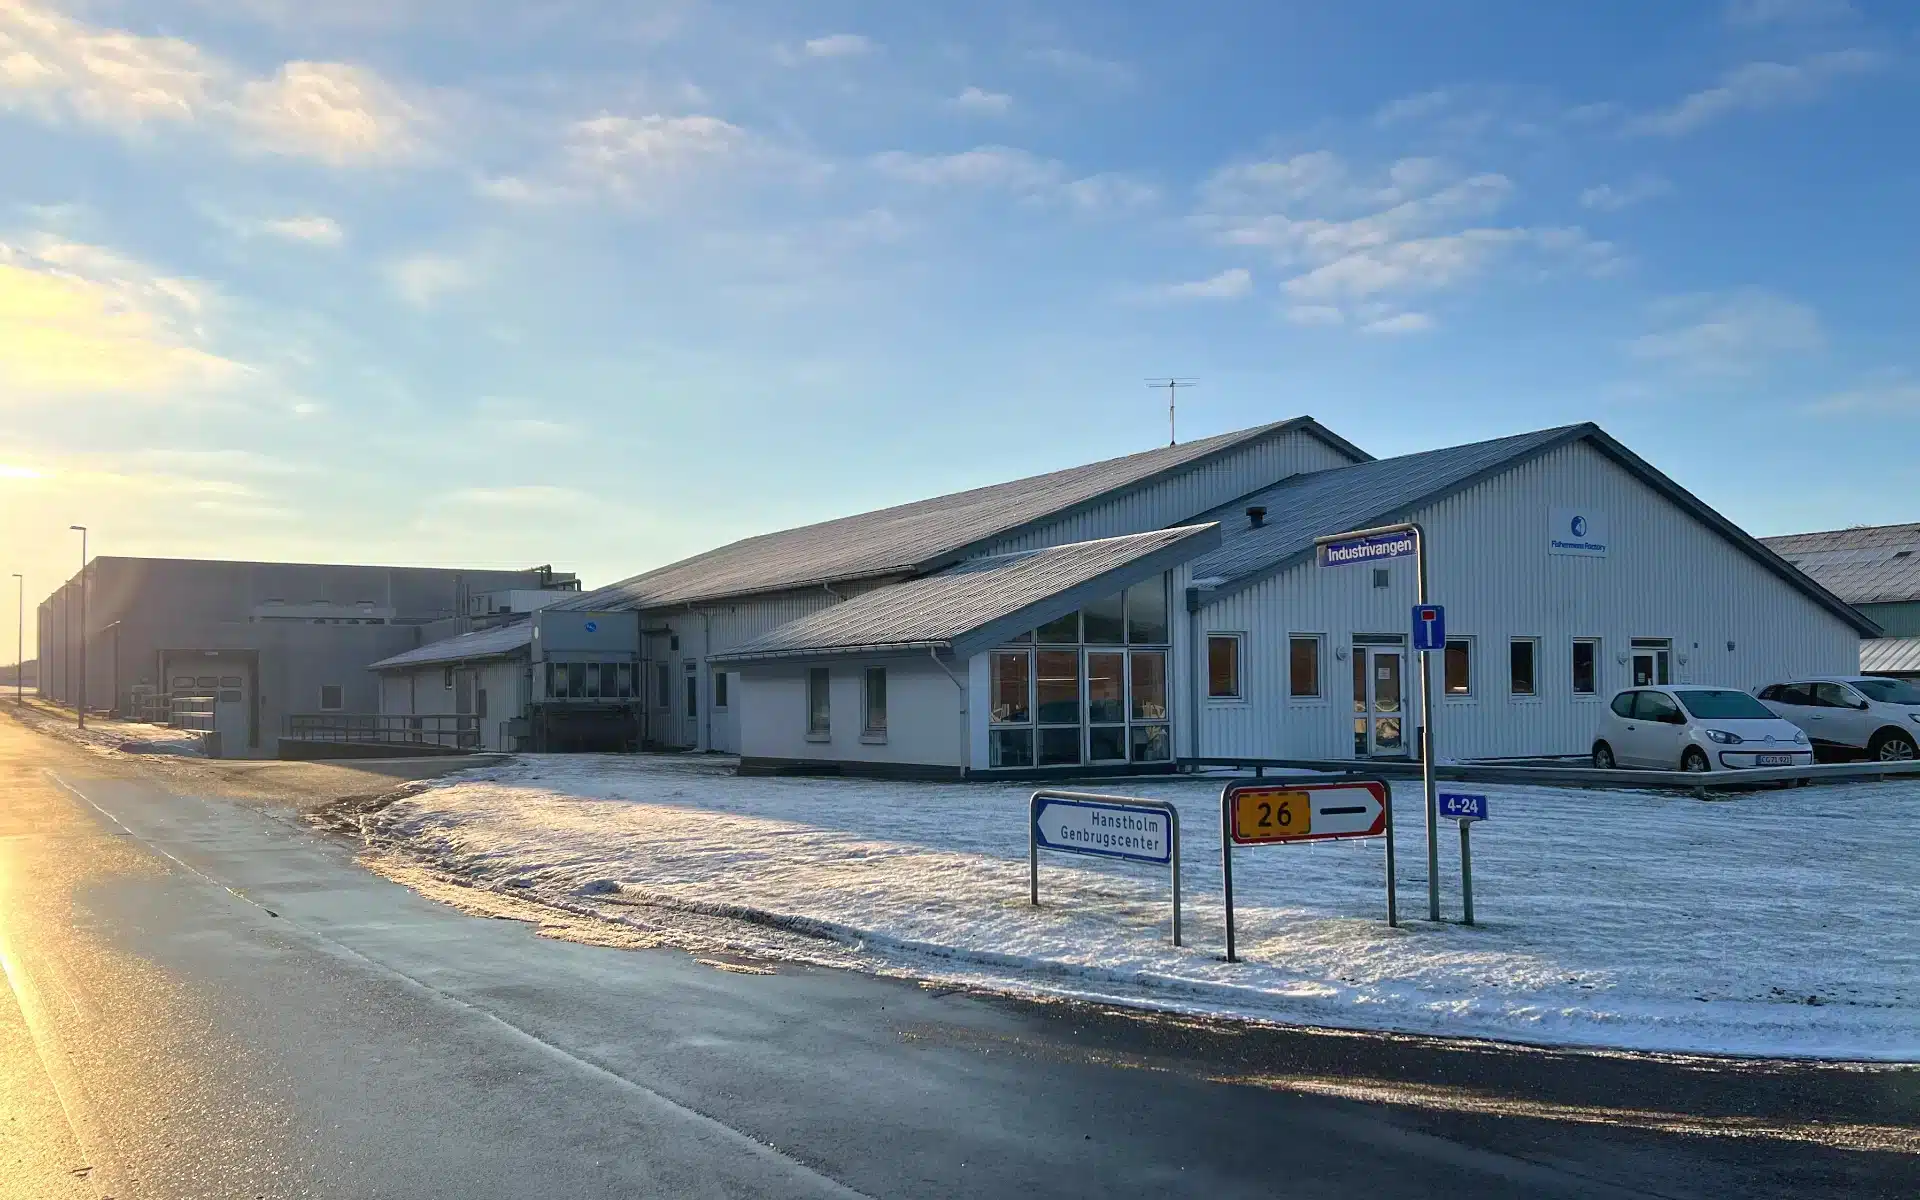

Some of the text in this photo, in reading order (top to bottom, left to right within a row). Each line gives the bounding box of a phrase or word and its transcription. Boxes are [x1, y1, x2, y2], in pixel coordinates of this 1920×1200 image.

[1328, 539, 1412, 562] Industrivangen
[1257, 801, 1292, 827] 26
[1447, 797, 1479, 814] 4-24
[1092, 811, 1158, 833] Hanstholm
[1060, 825, 1159, 851] Genbrugscenter
